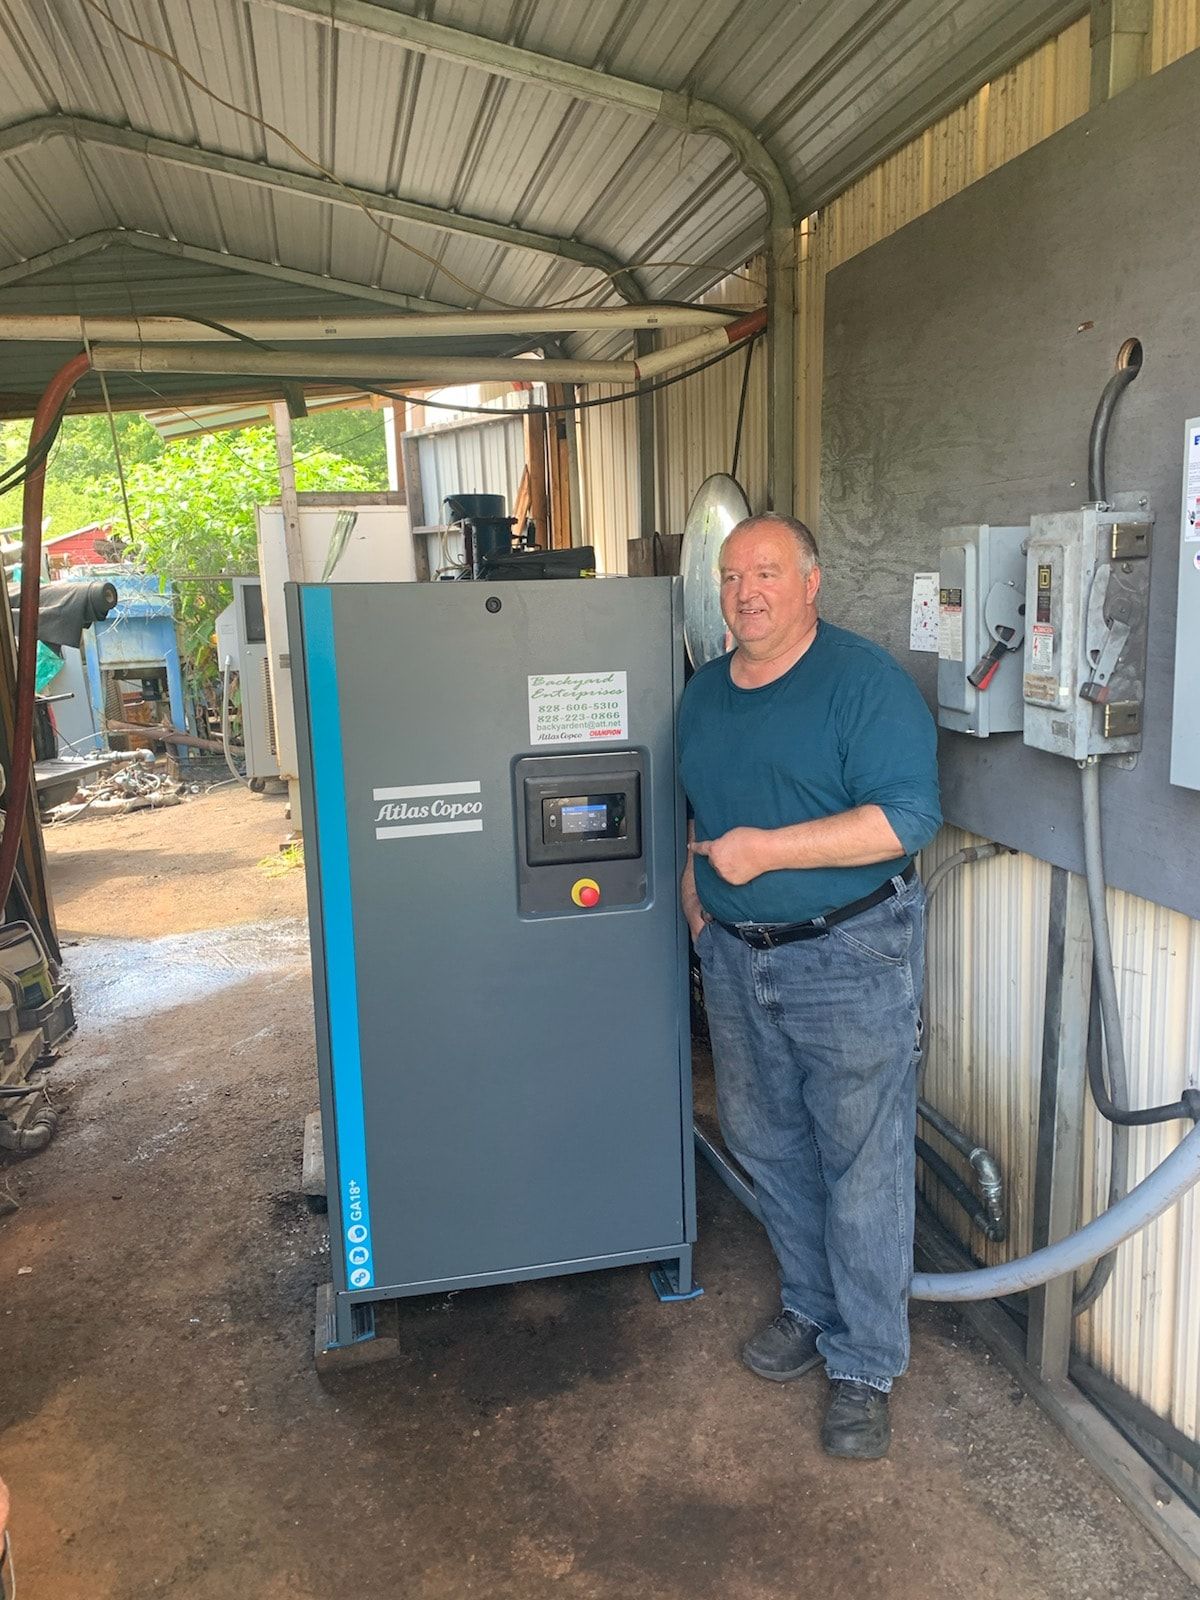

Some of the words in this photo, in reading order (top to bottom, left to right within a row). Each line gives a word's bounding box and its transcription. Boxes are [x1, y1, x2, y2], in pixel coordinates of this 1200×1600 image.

[532, 674, 615, 690] Backyard
[531, 688, 625, 700] Enterprises
[539, 702, 618, 712] 828-606-5310
[538, 712, 620, 723] 828-223-0866
[537, 720, 621, 731] backyardent@att.net
[537, 733, 560, 741] Atlas
[560, 731, 583, 741] Copco
[589, 729, 622, 737] CHAMPION
[374, 803, 429, 821] Atlas
[430, 799, 483, 819] Copco
[349, 1180, 362, 1220] GA18+
